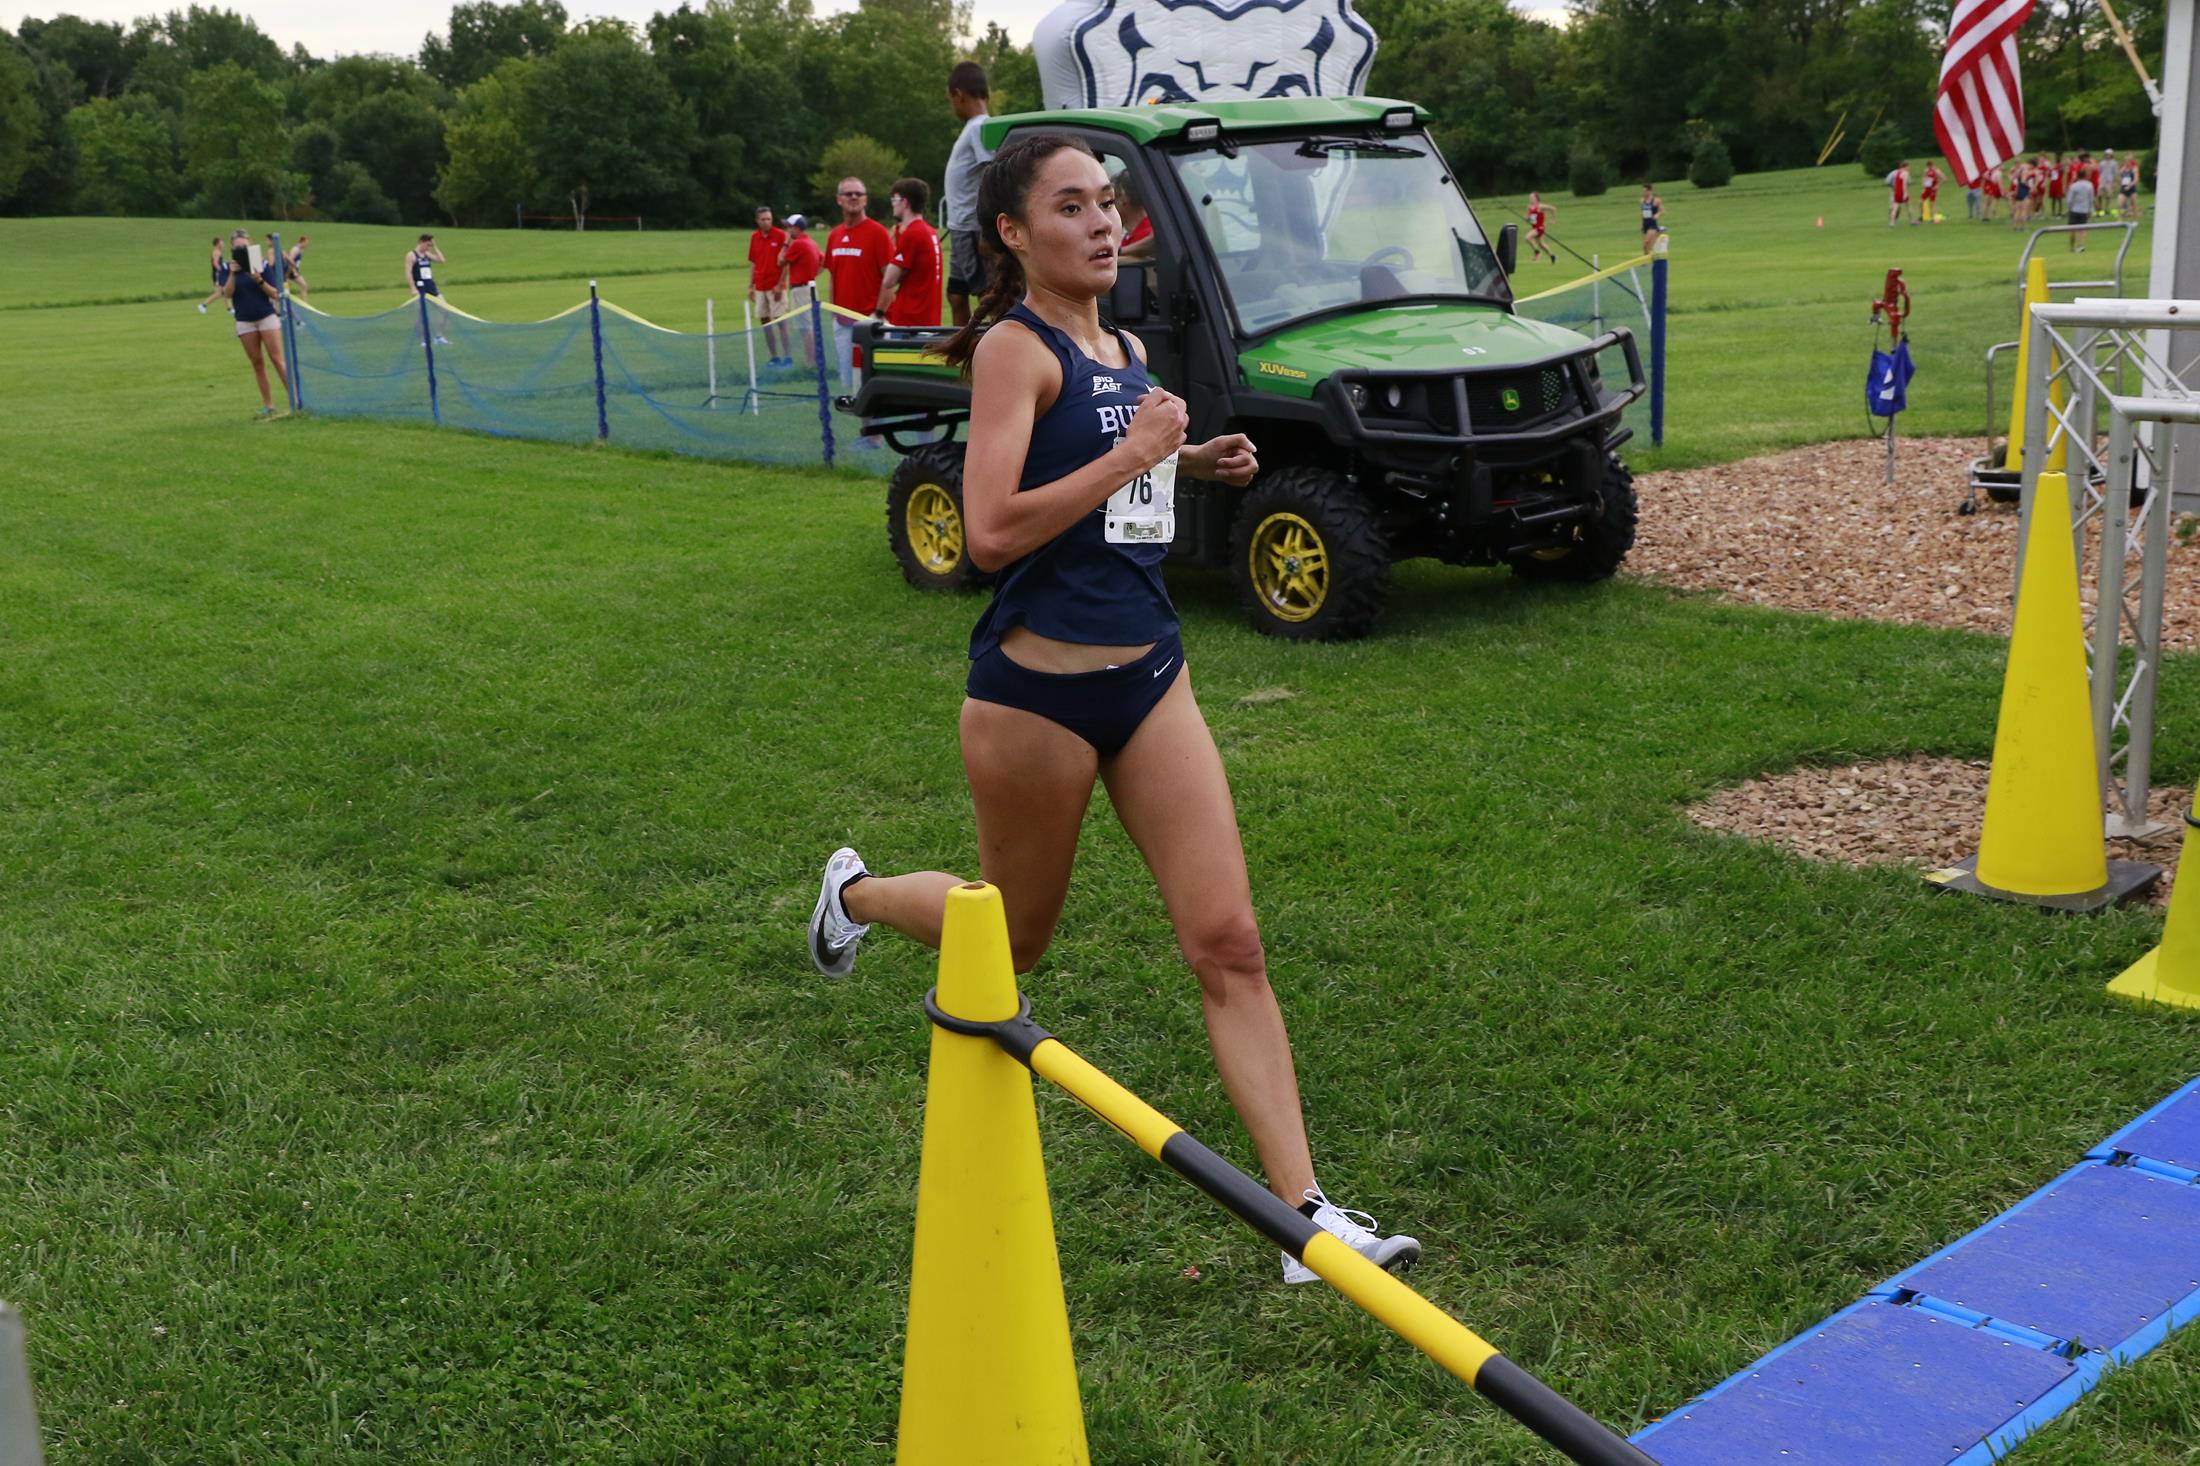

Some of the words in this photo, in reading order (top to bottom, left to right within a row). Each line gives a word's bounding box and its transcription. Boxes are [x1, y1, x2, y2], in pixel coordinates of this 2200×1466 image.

[1092, 375, 1114, 383] BIG
[1092, 382, 1122, 392] EAST
[1096, 404, 1141, 434] BU
